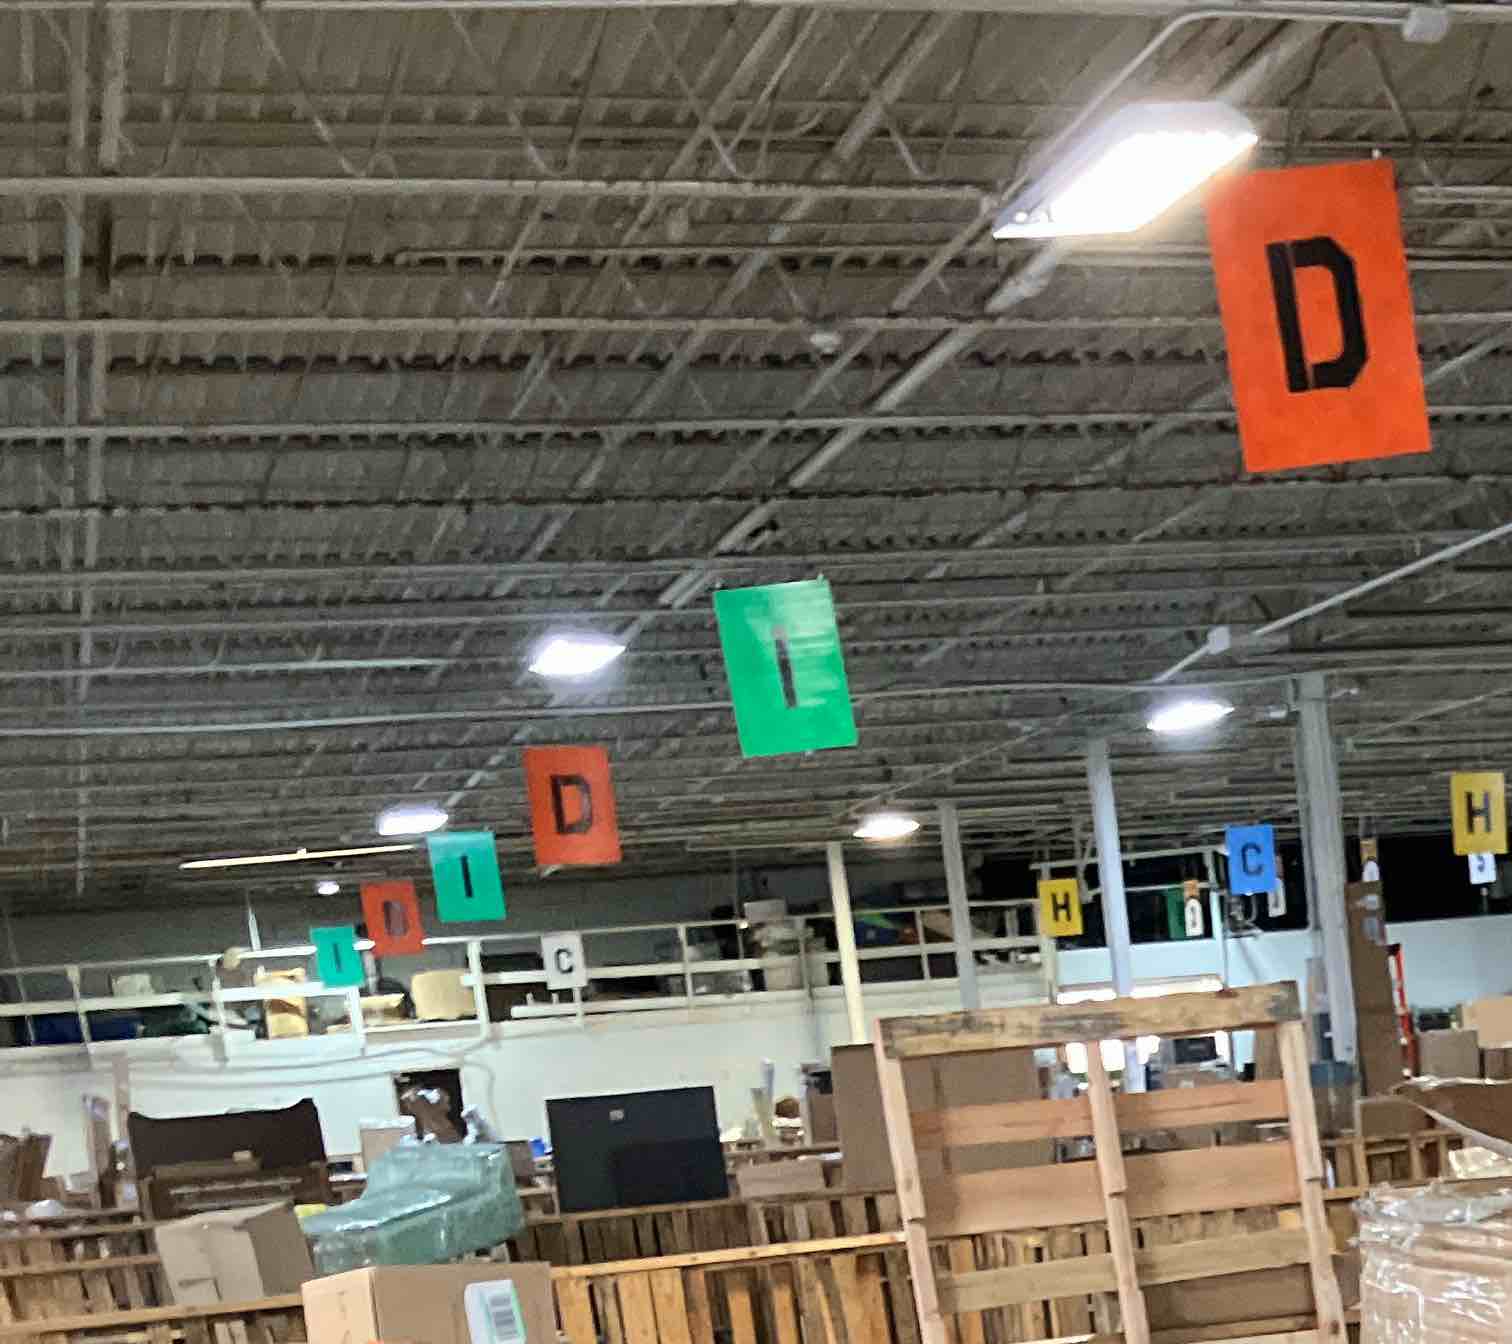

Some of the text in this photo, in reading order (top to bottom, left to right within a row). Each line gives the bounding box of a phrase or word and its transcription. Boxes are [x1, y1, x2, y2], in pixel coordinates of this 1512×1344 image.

[1266, 236, 1369, 393] D
[550, 773, 594, 834] D
[1465, 791, 1491, 833] H
[1241, 842, 1263, 876] C
[383, 900, 408, 938] D
[1051, 891, 1072, 923] H
[556, 948, 575, 975] C
